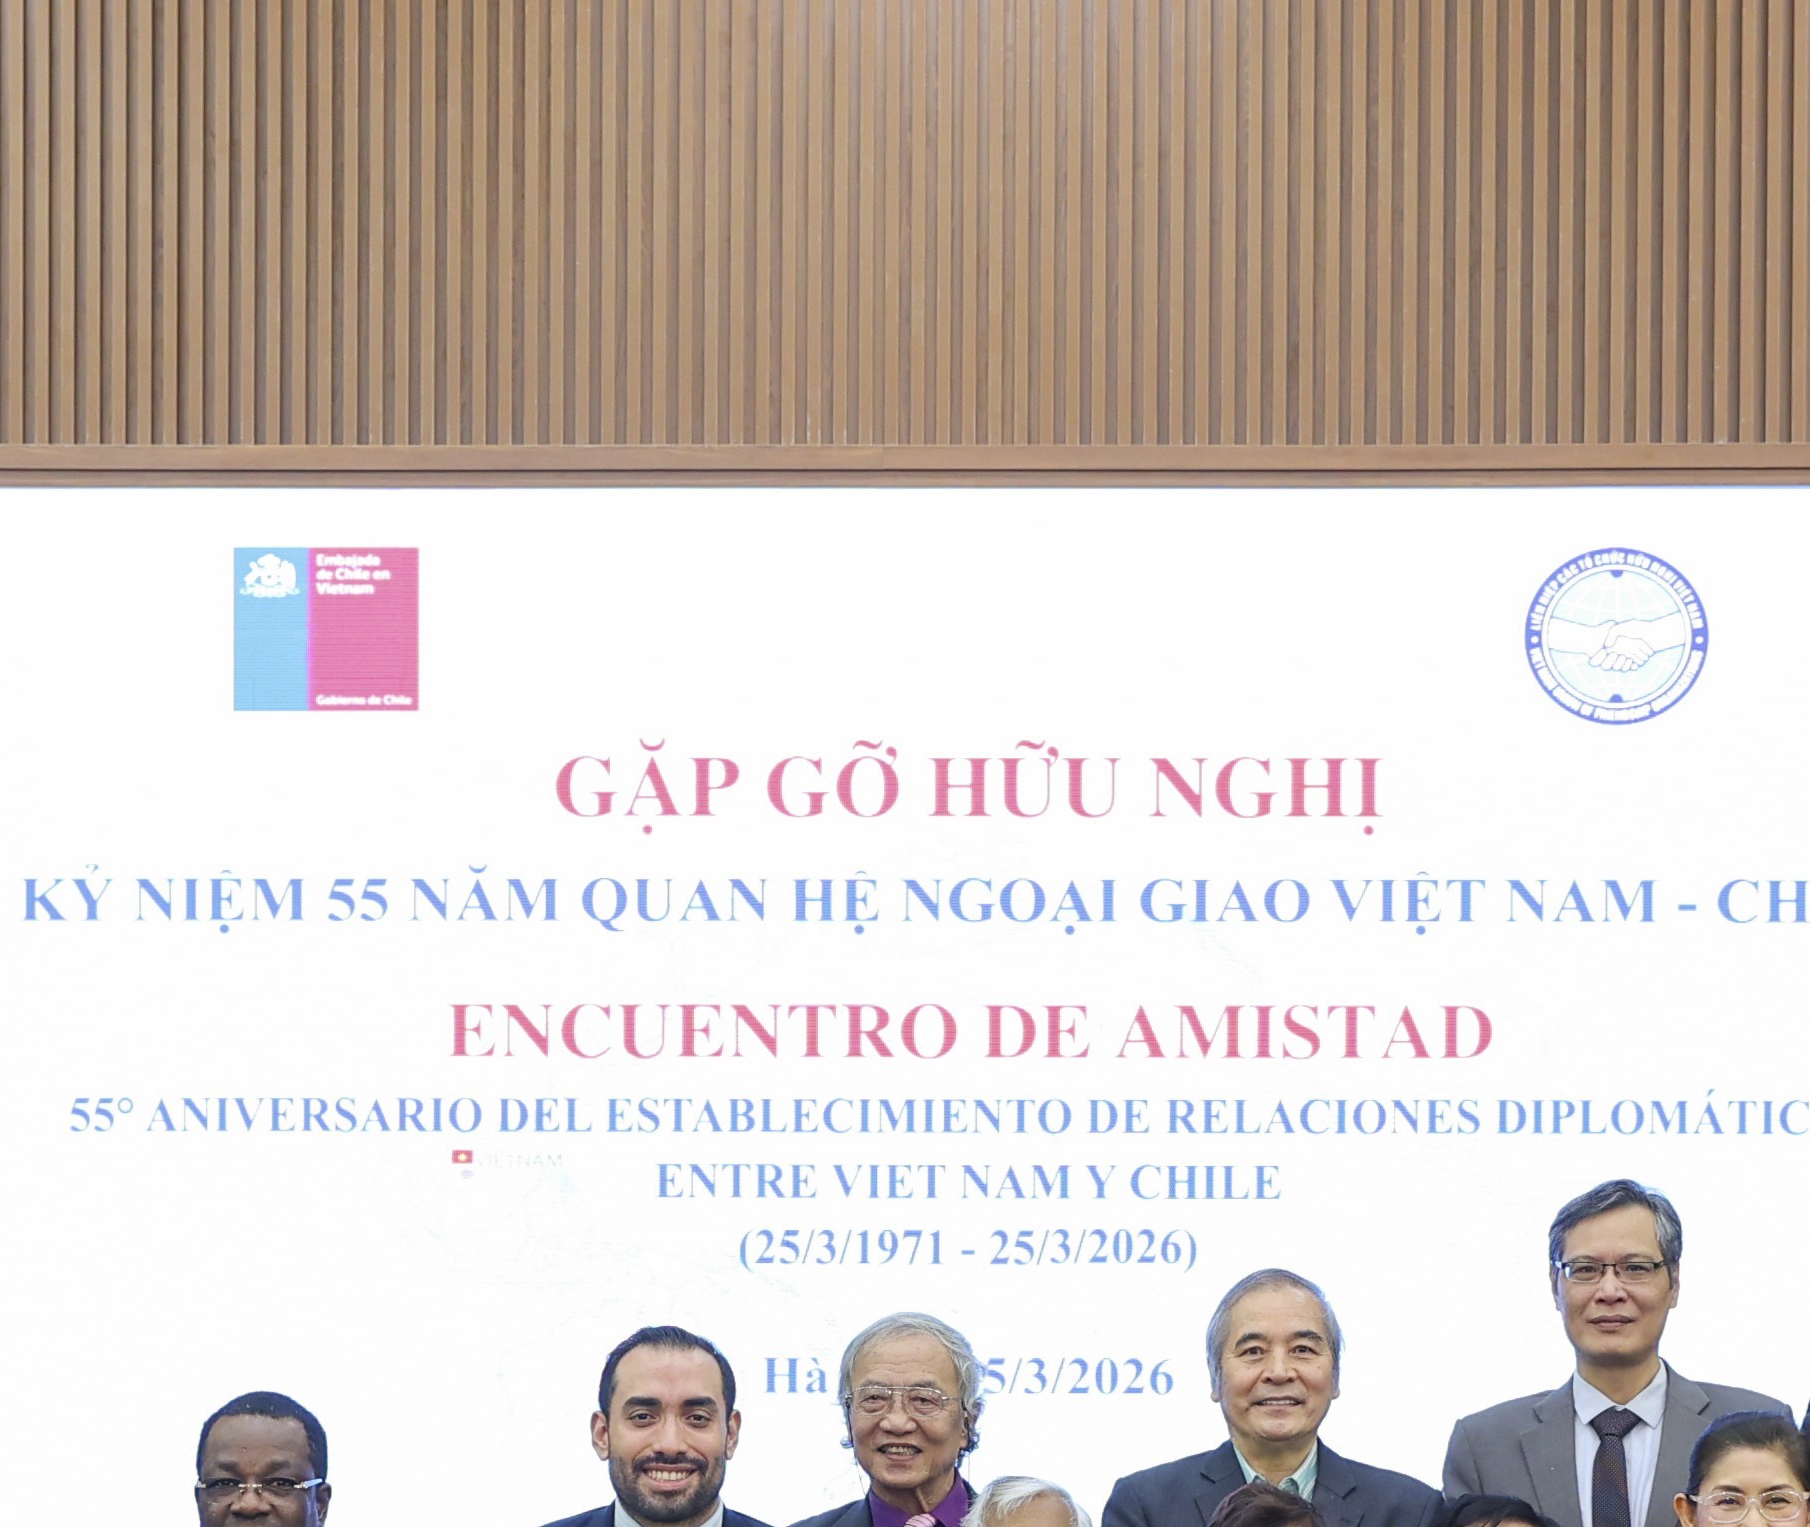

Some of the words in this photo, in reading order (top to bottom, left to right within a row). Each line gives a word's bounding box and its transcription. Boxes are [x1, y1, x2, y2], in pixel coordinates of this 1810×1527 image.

[316, 553, 381, 569] Embajada
[316, 568, 333, 580] de
[335, 568, 371, 580] Chile
[372, 570, 391, 580] en
[316, 582, 375, 595] Vietnam
[368, 694, 381, 706] de
[383, 694, 412, 706] Chile
[556, 739, 739, 835] GẶP
[767, 740, 899, 818] GỠ
[930, 740, 1119, 818] HỮU
[1150, 757, 1382, 836] NGHỊ
[24, 864, 112, 920] KỶ
[136, 870, 303, 933] NIỆM
[328, 879, 388, 921] 55
[412, 865, 556, 920] NĂM
[582, 878, 766, 931] QUAN
[794, 871, 878, 935] HỆ
[903, 878, 1116, 936] NGOẠI
[1140, 879, 1310, 922] GIAO
[1331, 872, 1485, 936] VIỆT
[1506, 880, 1654, 922] NAM
[451, 1004, 957, 1059] ENCUENTRO
[986, 1005, 1089, 1057] DE
[1117, 1005, 1492, 1059] AMISTAD
[147, 1098, 482, 1133] ANIVERSARIO
[499, 1098, 591, 1132] DEL
[608, 1098, 1071, 1134] ESTABLECIMIENTO
[1089, 1100, 1149, 1133] DE
[1168, 1099, 1480, 1134] RELACIONES
[657, 1164, 816, 1198] ENTRE
[834, 1165, 946, 1198] VIET
[962, 1165, 1070, 1199] NAM
[1086, 1165, 1116, 1199] Y
[1130, 1164, 1280, 1199] CHILE
[740, 1229, 941, 1272] (25/3/1971
[990, 1229, 1196, 1271] 25/3/2026)
[765, 1357, 827, 1393] Hà
[984, 1357, 1174, 1395] 5/3/2026
